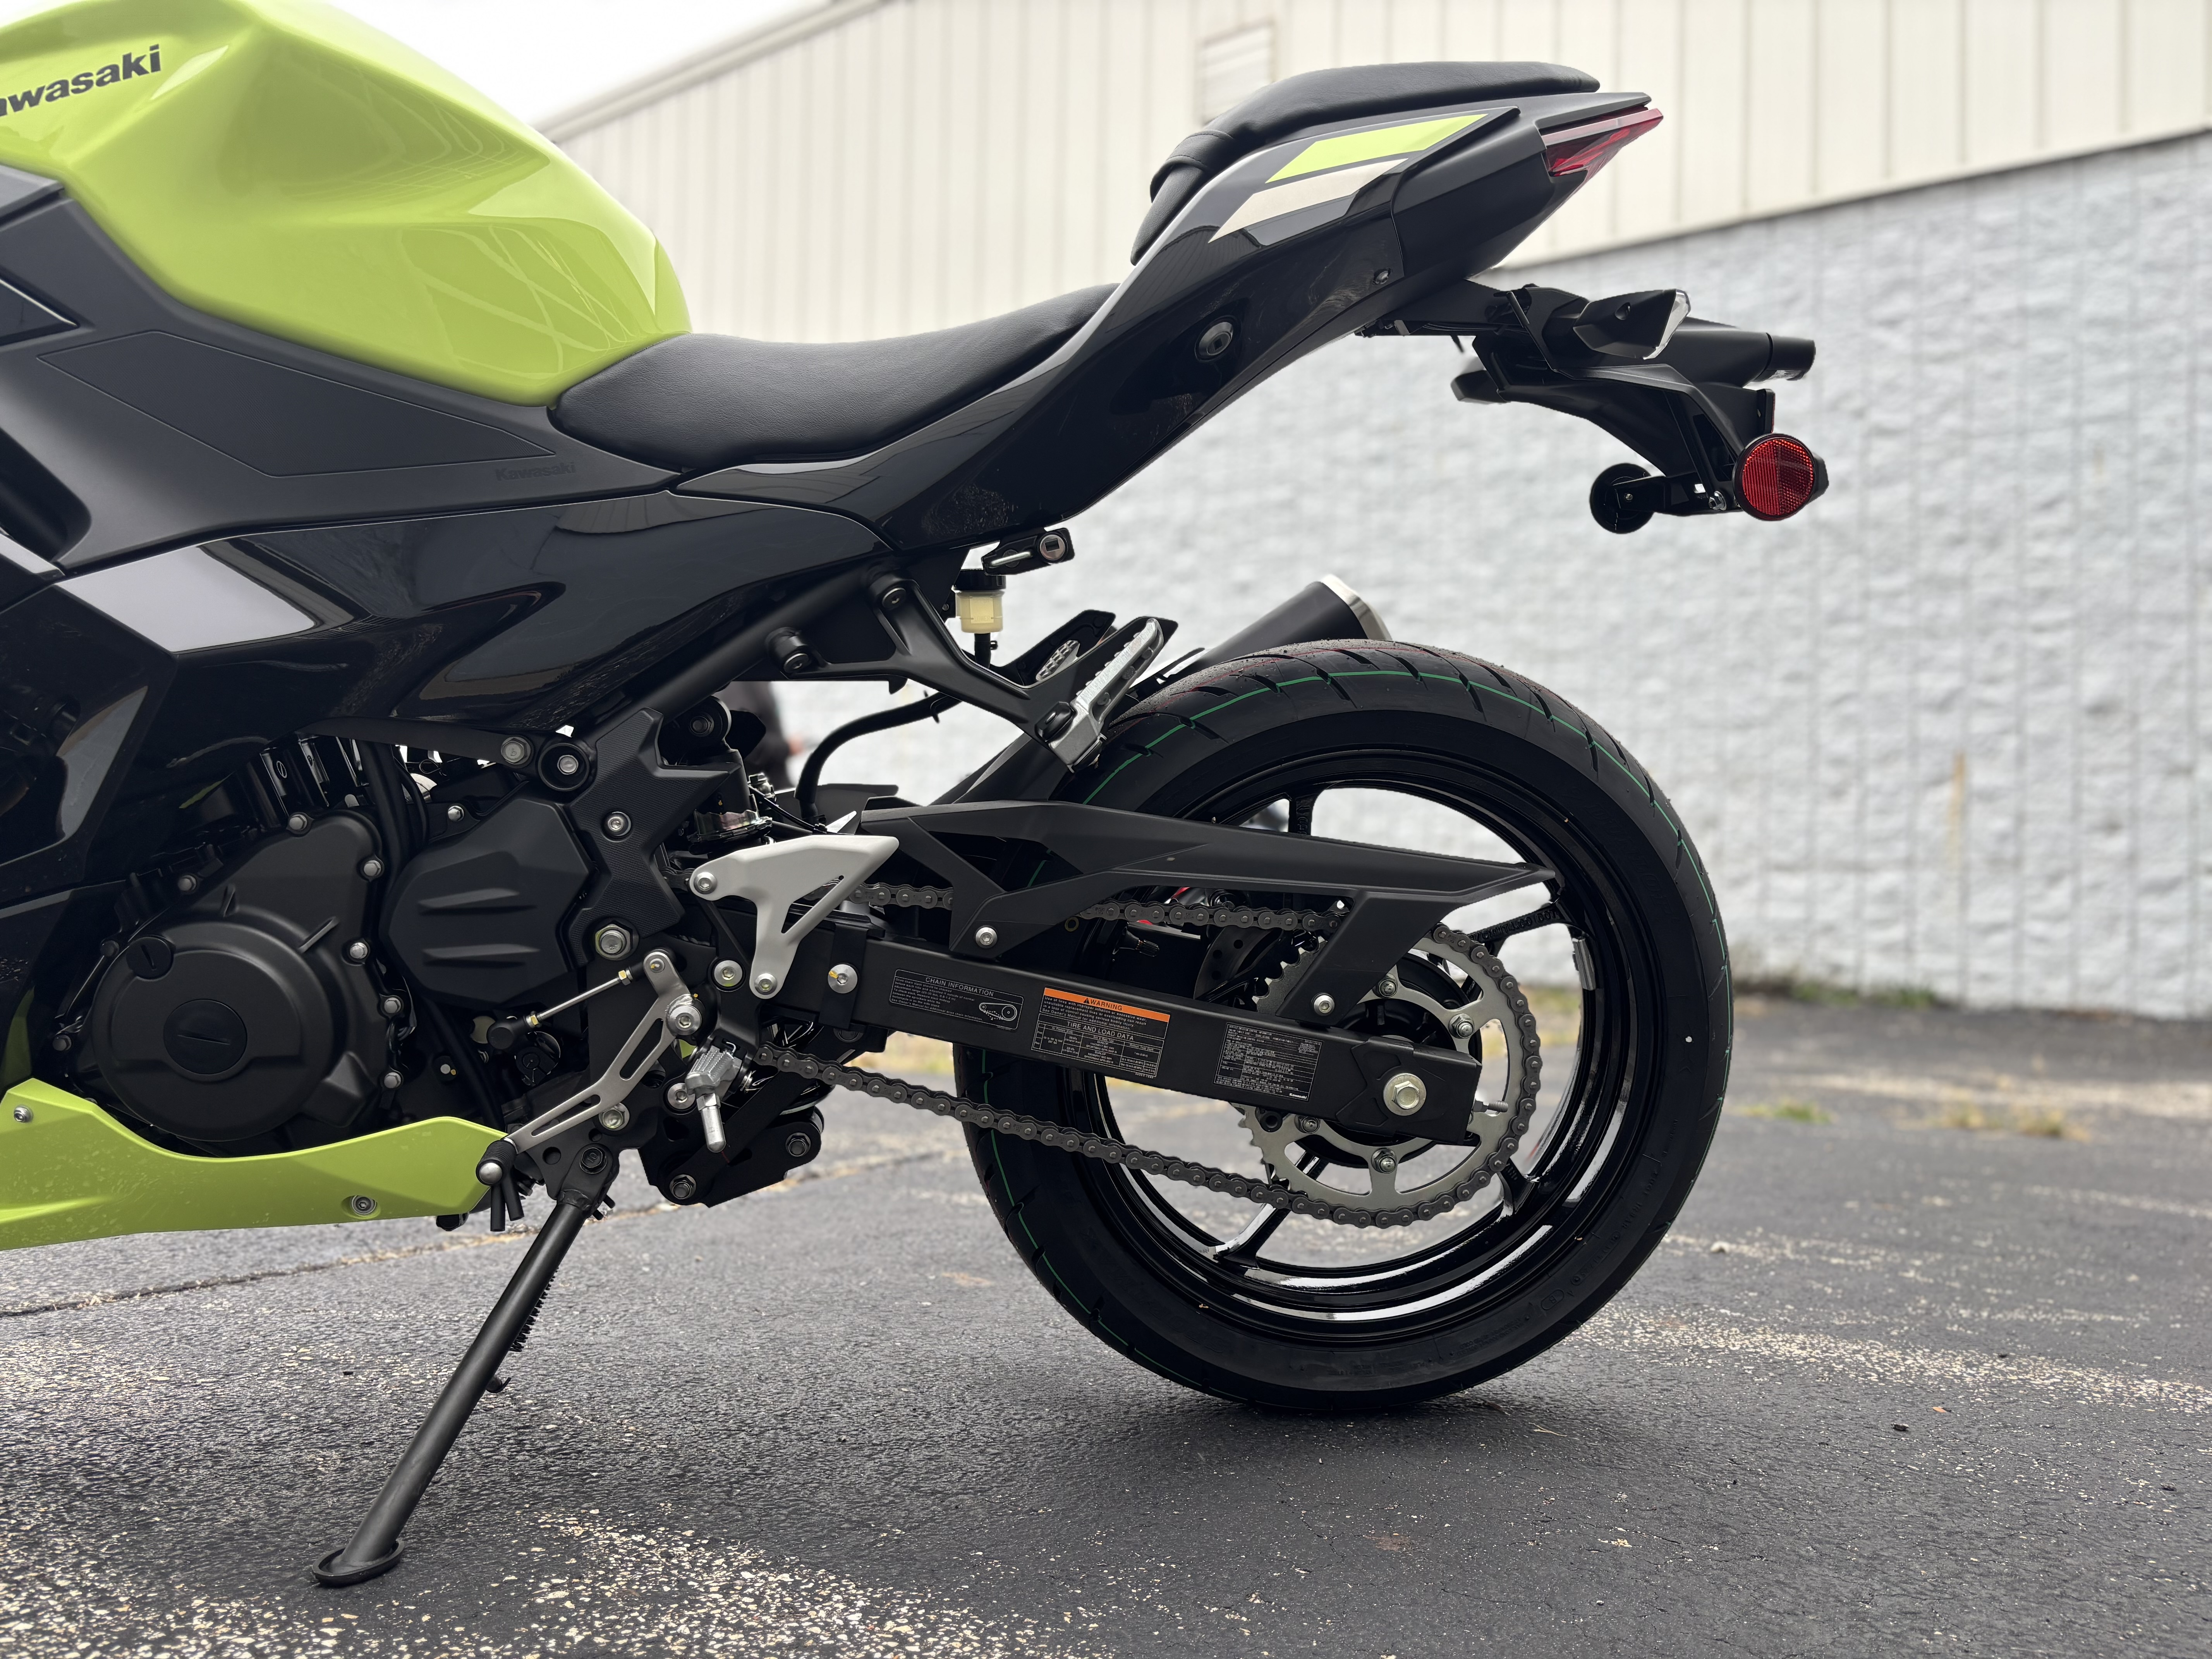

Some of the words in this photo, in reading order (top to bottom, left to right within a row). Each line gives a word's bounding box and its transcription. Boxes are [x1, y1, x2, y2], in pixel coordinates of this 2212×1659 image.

[0, 44, 161, 117] wasaki
[495, 461, 576, 481] Kawasaki
[925, 977, 947, 986] CHAIN
[948, 982, 994, 996] INFORMATION
[1065, 1005, 1088, 1013] replacement
[1090, 999, 1122, 1010] WARNING
[1066, 1021, 1082, 1029] TIRE
[1098, 1028, 1115, 1036] LOAD
[1116, 1032, 1134, 1041] DATA
